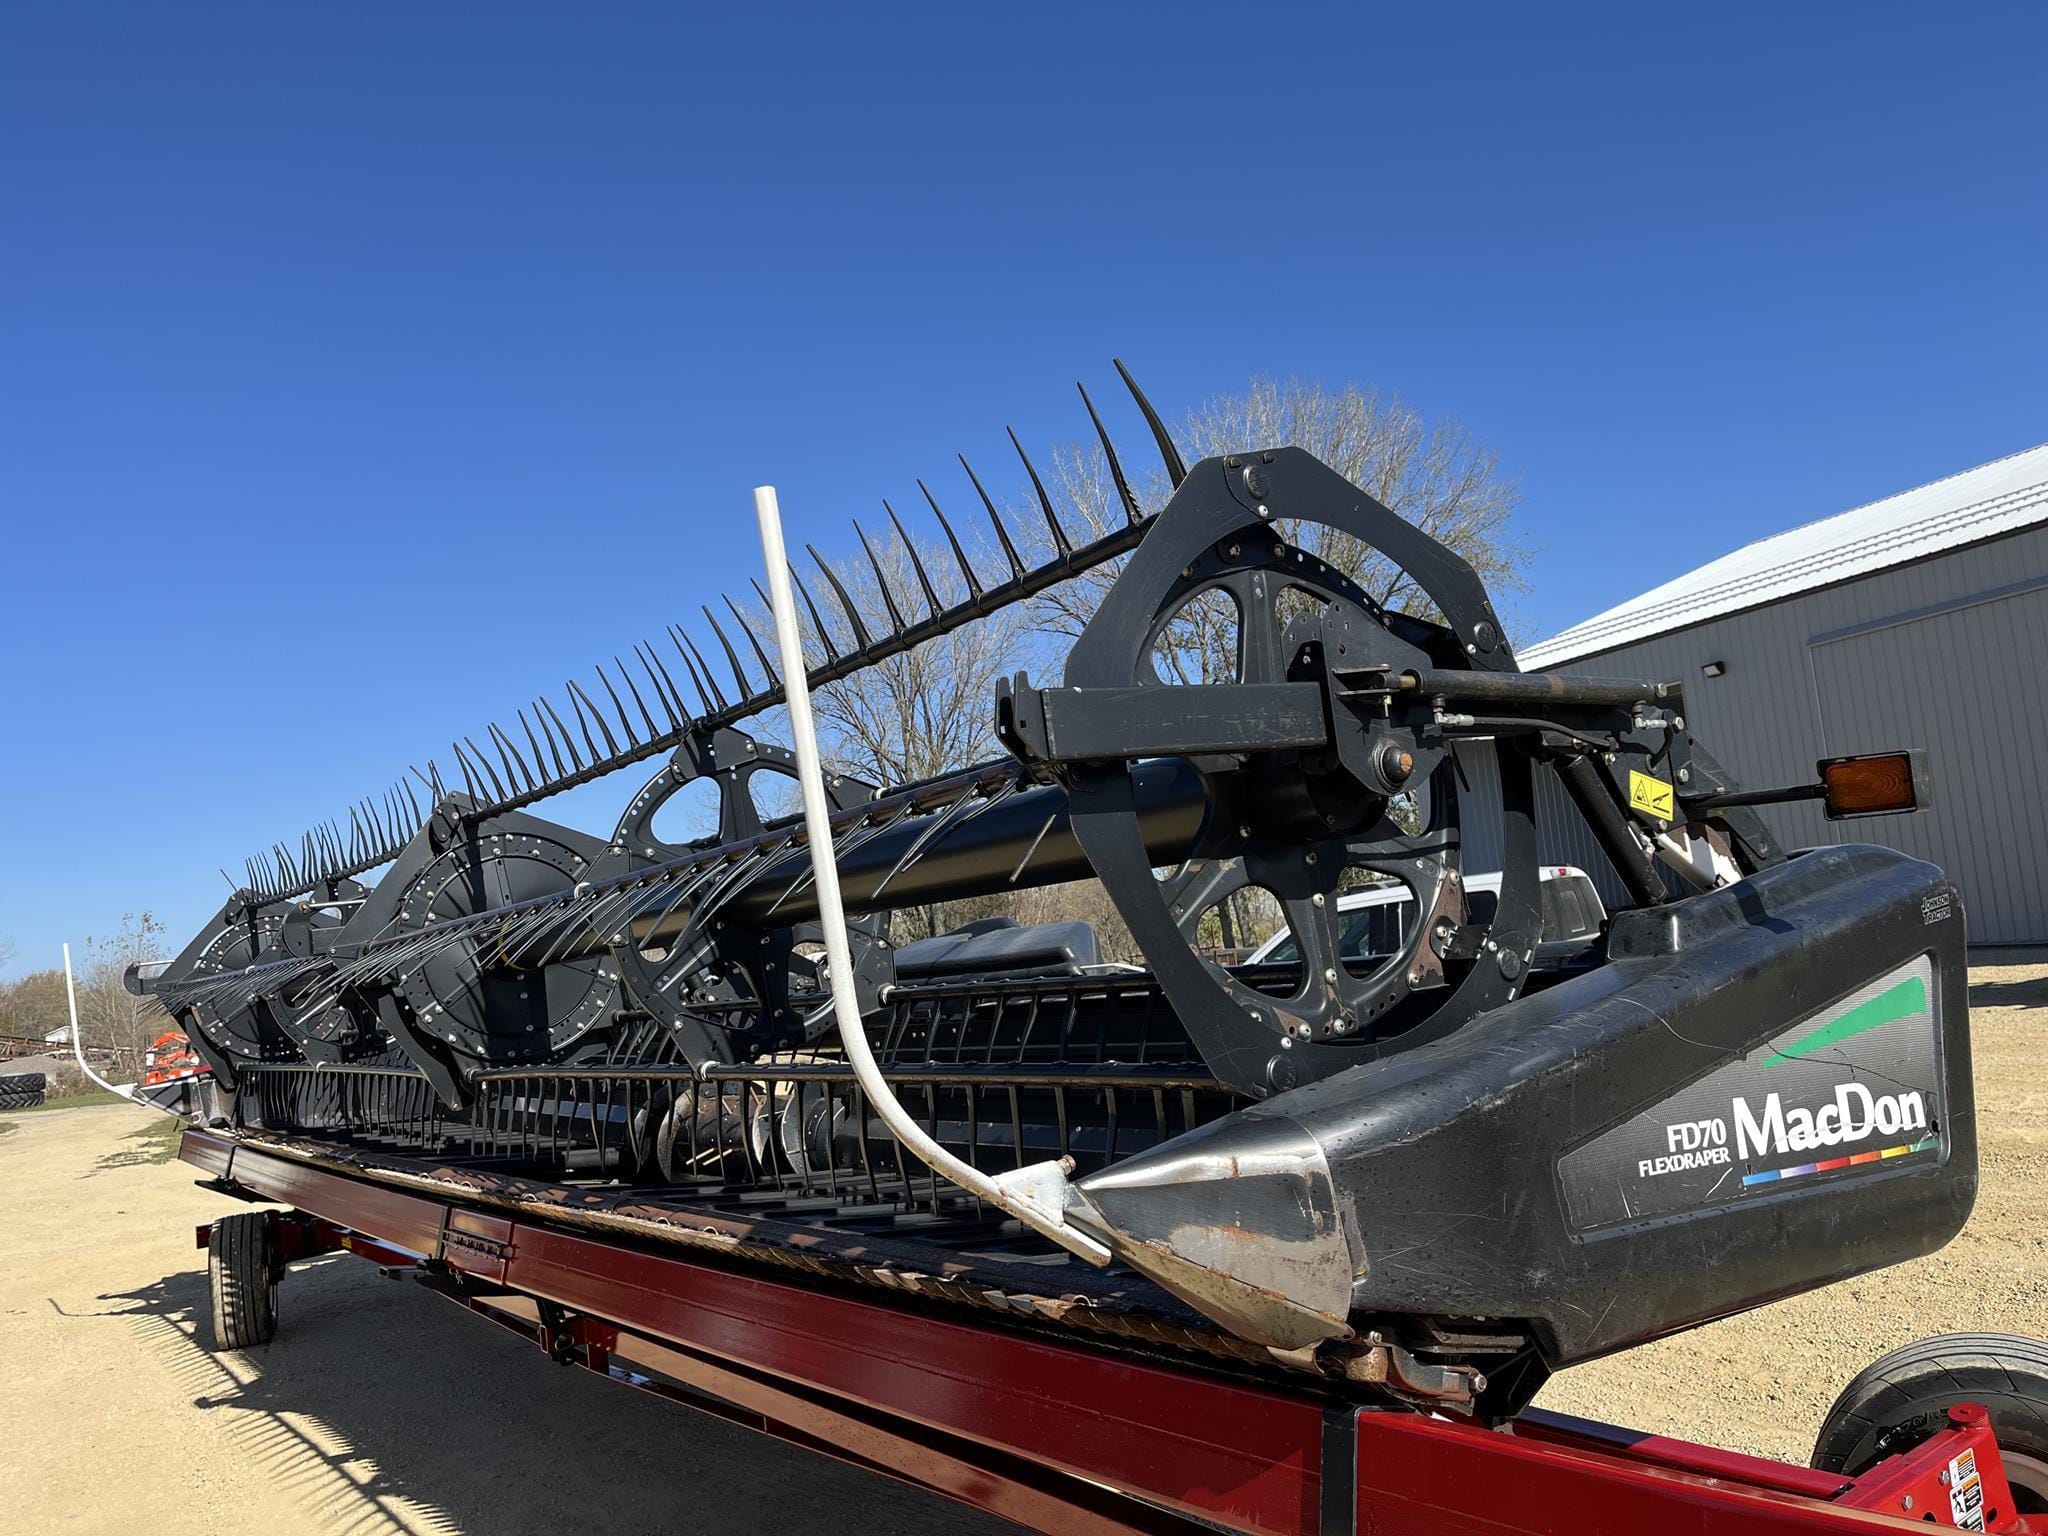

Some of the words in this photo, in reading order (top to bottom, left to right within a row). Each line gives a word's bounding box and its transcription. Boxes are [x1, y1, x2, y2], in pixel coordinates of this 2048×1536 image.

[1666, 1118, 1727, 1153] FD70
[1732, 1082, 1927, 1160] MacDon
[1638, 1147, 1732, 1178] FLEXDRAPER
